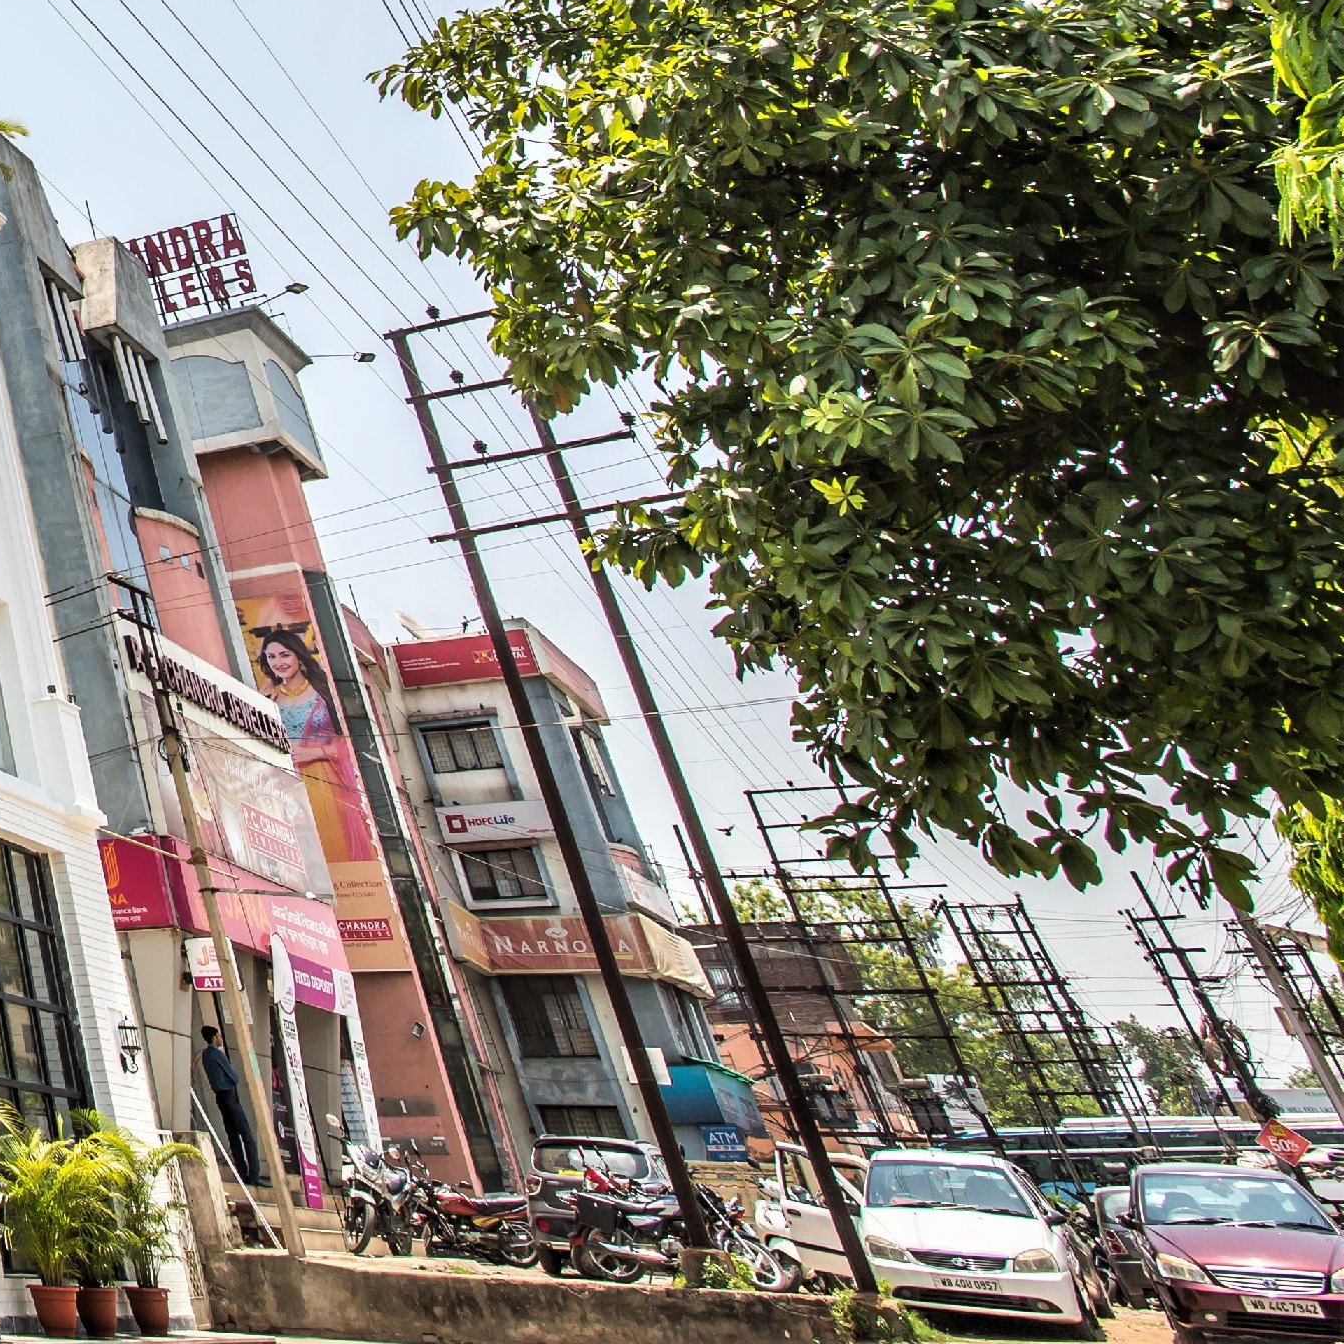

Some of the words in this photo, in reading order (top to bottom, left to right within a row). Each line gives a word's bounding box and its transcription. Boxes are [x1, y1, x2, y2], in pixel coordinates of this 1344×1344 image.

[159, 259, 255, 313] LERS
[468, 818, 494, 827] HDFC
[494, 814, 515, 825] Life
[339, 880, 383, 889] Collection
[132, 906, 148, 914] Bank
[338, 921, 389, 931] CHANDRA
[494, 935, 632, 954] NARNOA
[709, 1131, 739, 1144] ATM
[1267, 1136, 1300, 1152] 50%
[939, 1277, 953, 1287] WB
[1250, 1299, 1266, 1310] WB
